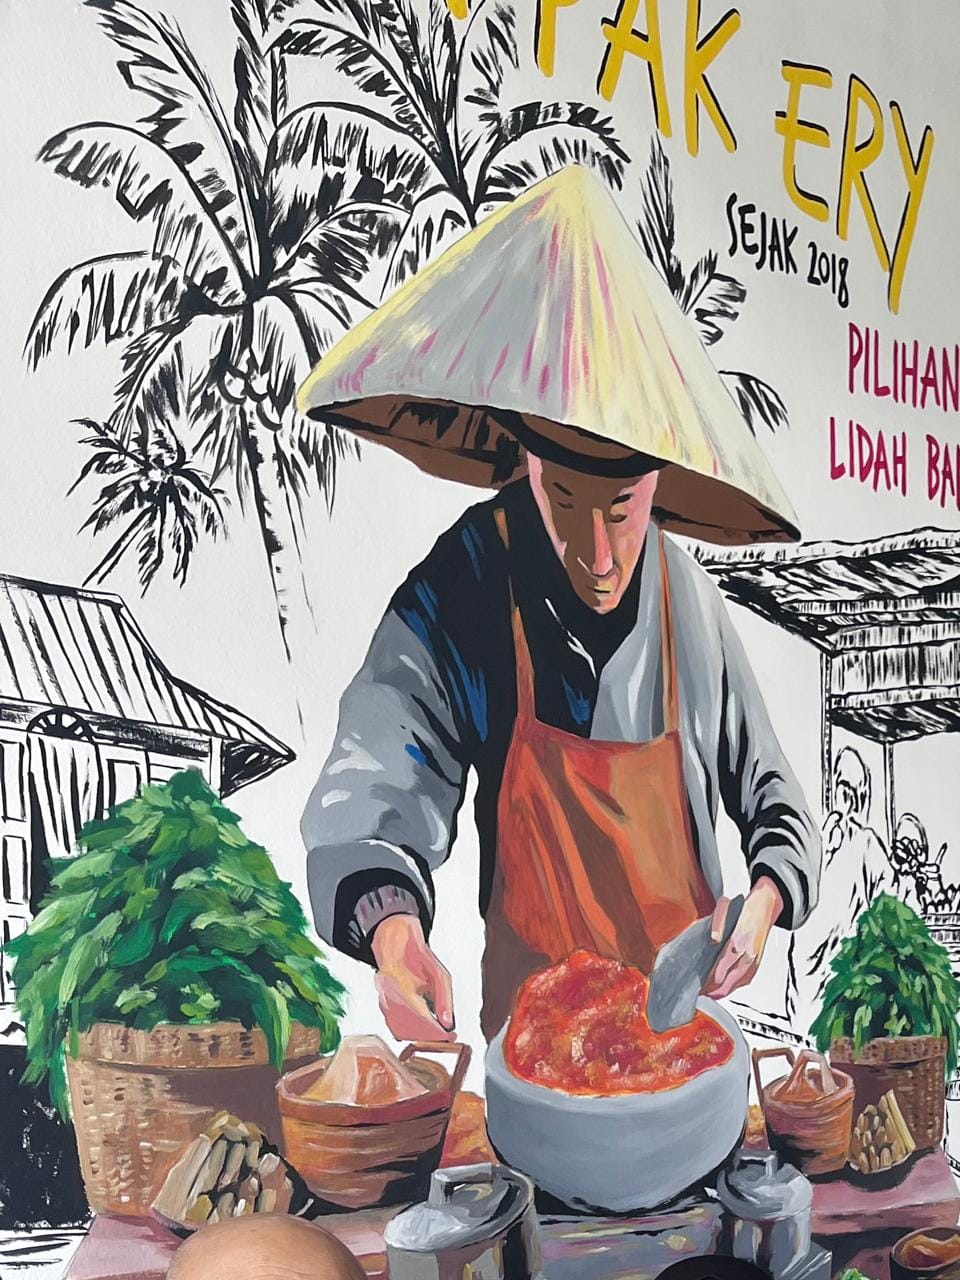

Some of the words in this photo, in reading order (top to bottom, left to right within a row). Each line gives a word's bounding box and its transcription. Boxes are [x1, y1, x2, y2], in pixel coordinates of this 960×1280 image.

[774, 59, 935, 315] ERY
[726, 192, 799, 275] SEJAK
[807, 241, 849, 308] 2018
[848, 322, 960, 412] PILIHAN
[830, 416, 907, 497] LIDAH
